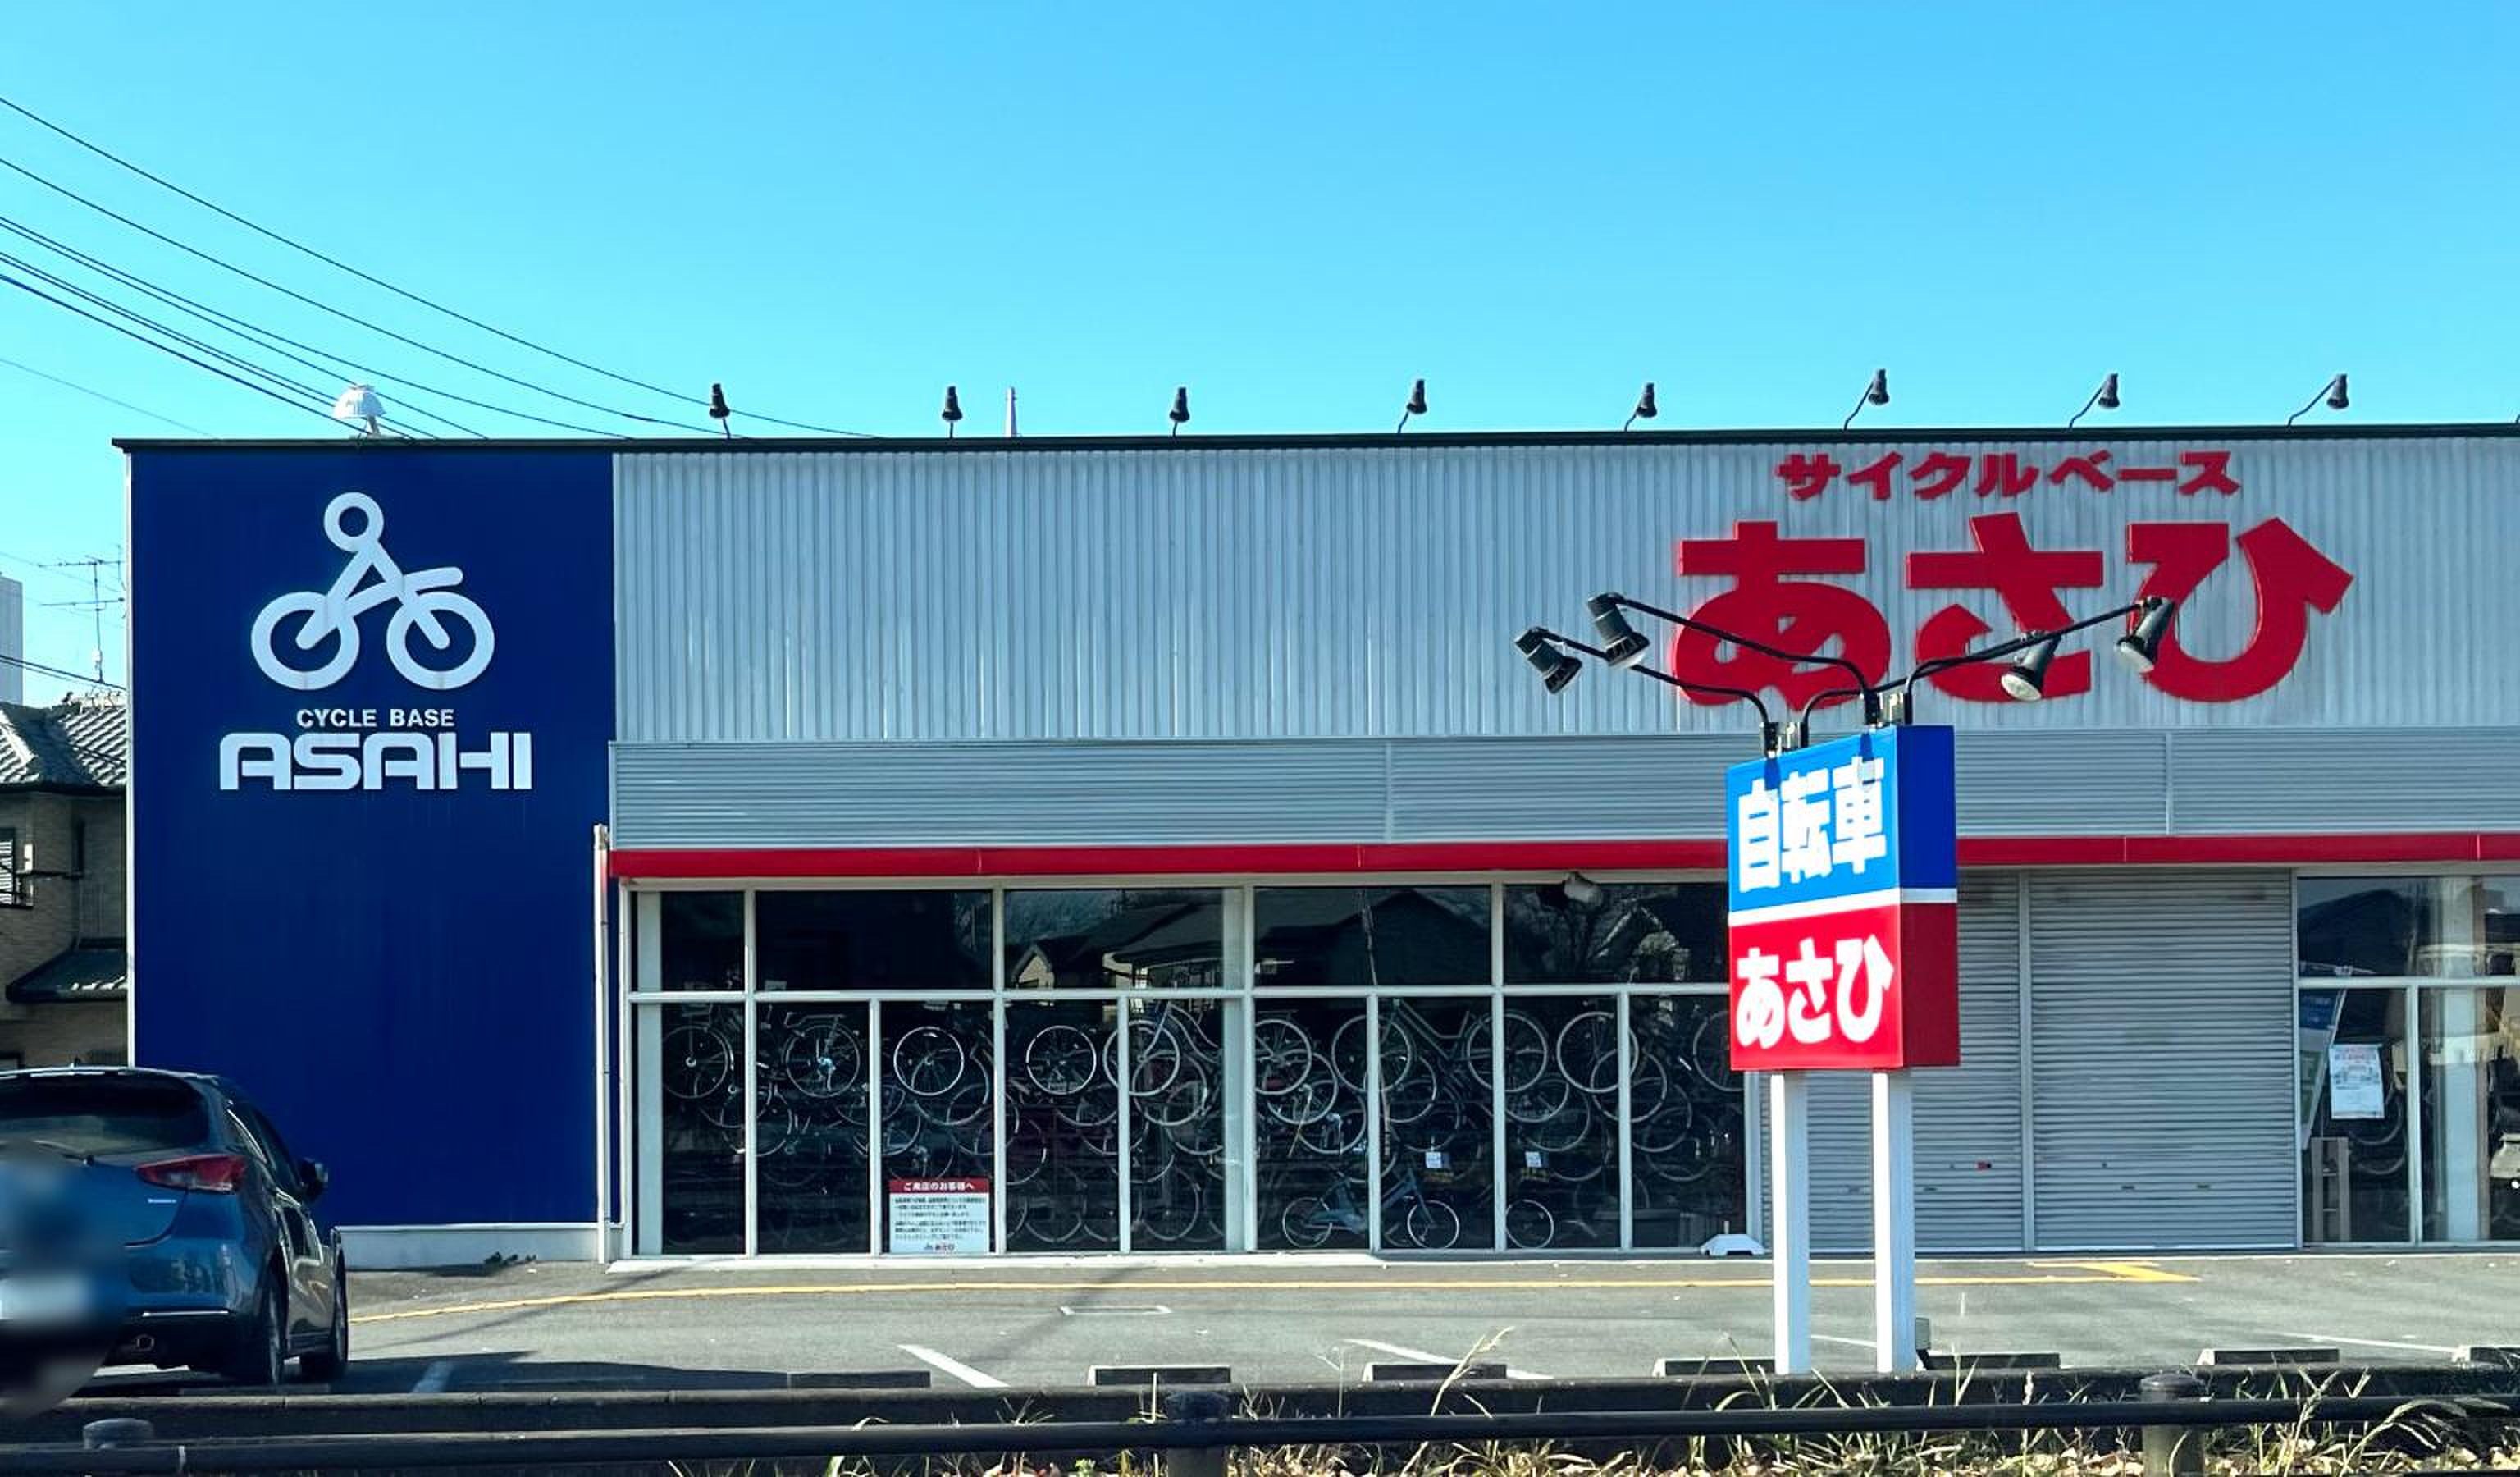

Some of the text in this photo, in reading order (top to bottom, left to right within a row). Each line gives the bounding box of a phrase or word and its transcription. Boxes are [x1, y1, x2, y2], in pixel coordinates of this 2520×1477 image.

[1778, 450, 2241, 501] サイクルベース
[1673, 512, 2354, 711] あさひ
[219, 732, 533, 791] ASAHI
[296, 708, 456, 729] CYCLE BASE
[1737, 755, 1887, 894] 自転車
[1737, 934, 1893, 1049] あさひ
